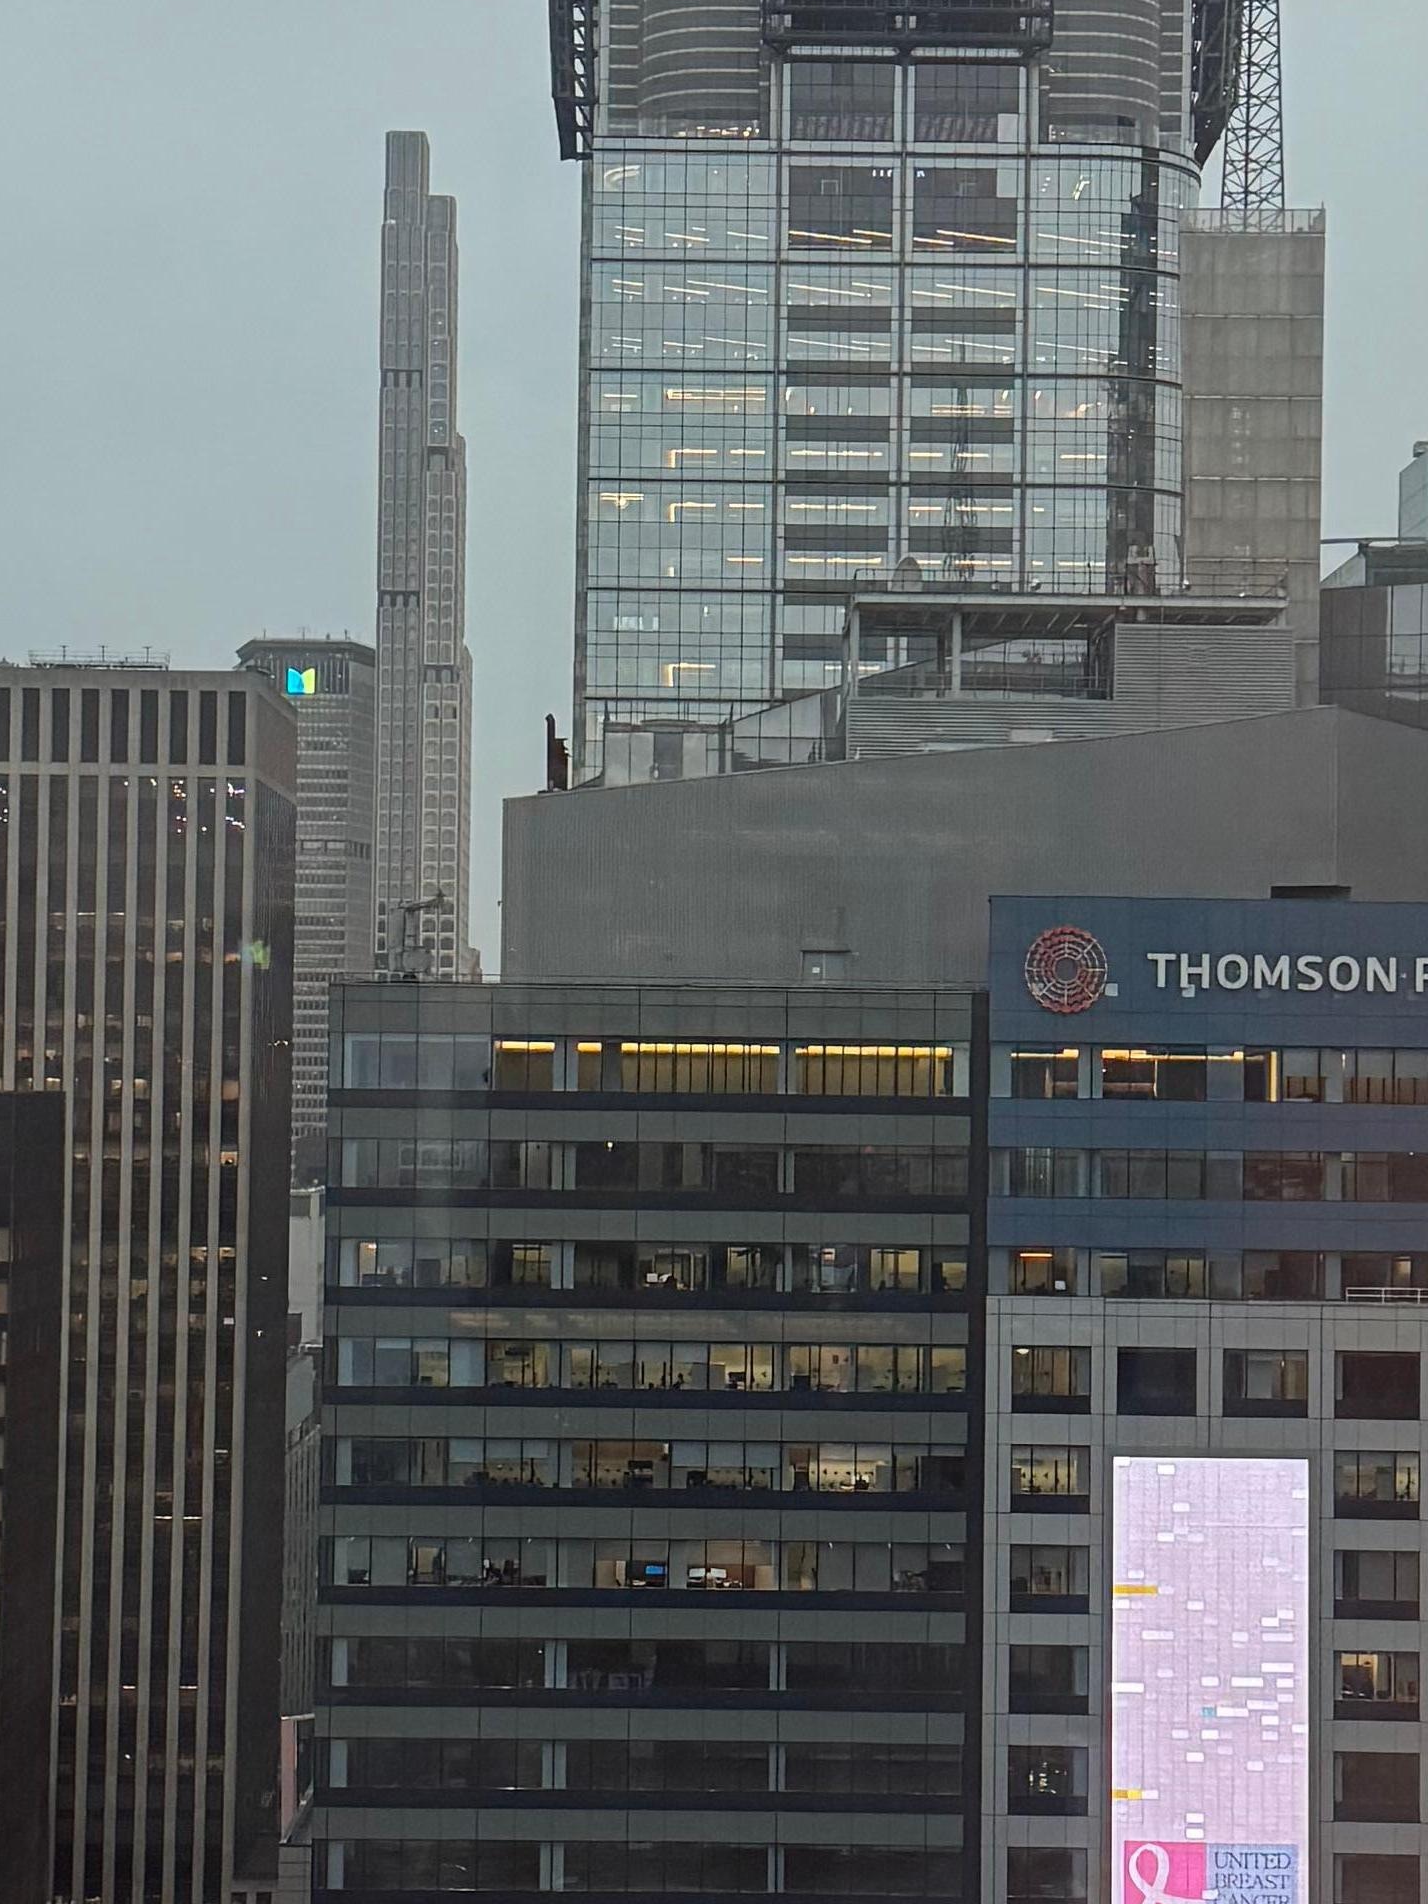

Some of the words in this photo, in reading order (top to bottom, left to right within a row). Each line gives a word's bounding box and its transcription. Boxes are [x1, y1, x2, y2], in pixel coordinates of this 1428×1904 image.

[1146, 951, 1398, 994] THOMSON
[1214, 1852, 1292, 1869] UNITED
[1214, 1874, 1291, 1890] BREAST
